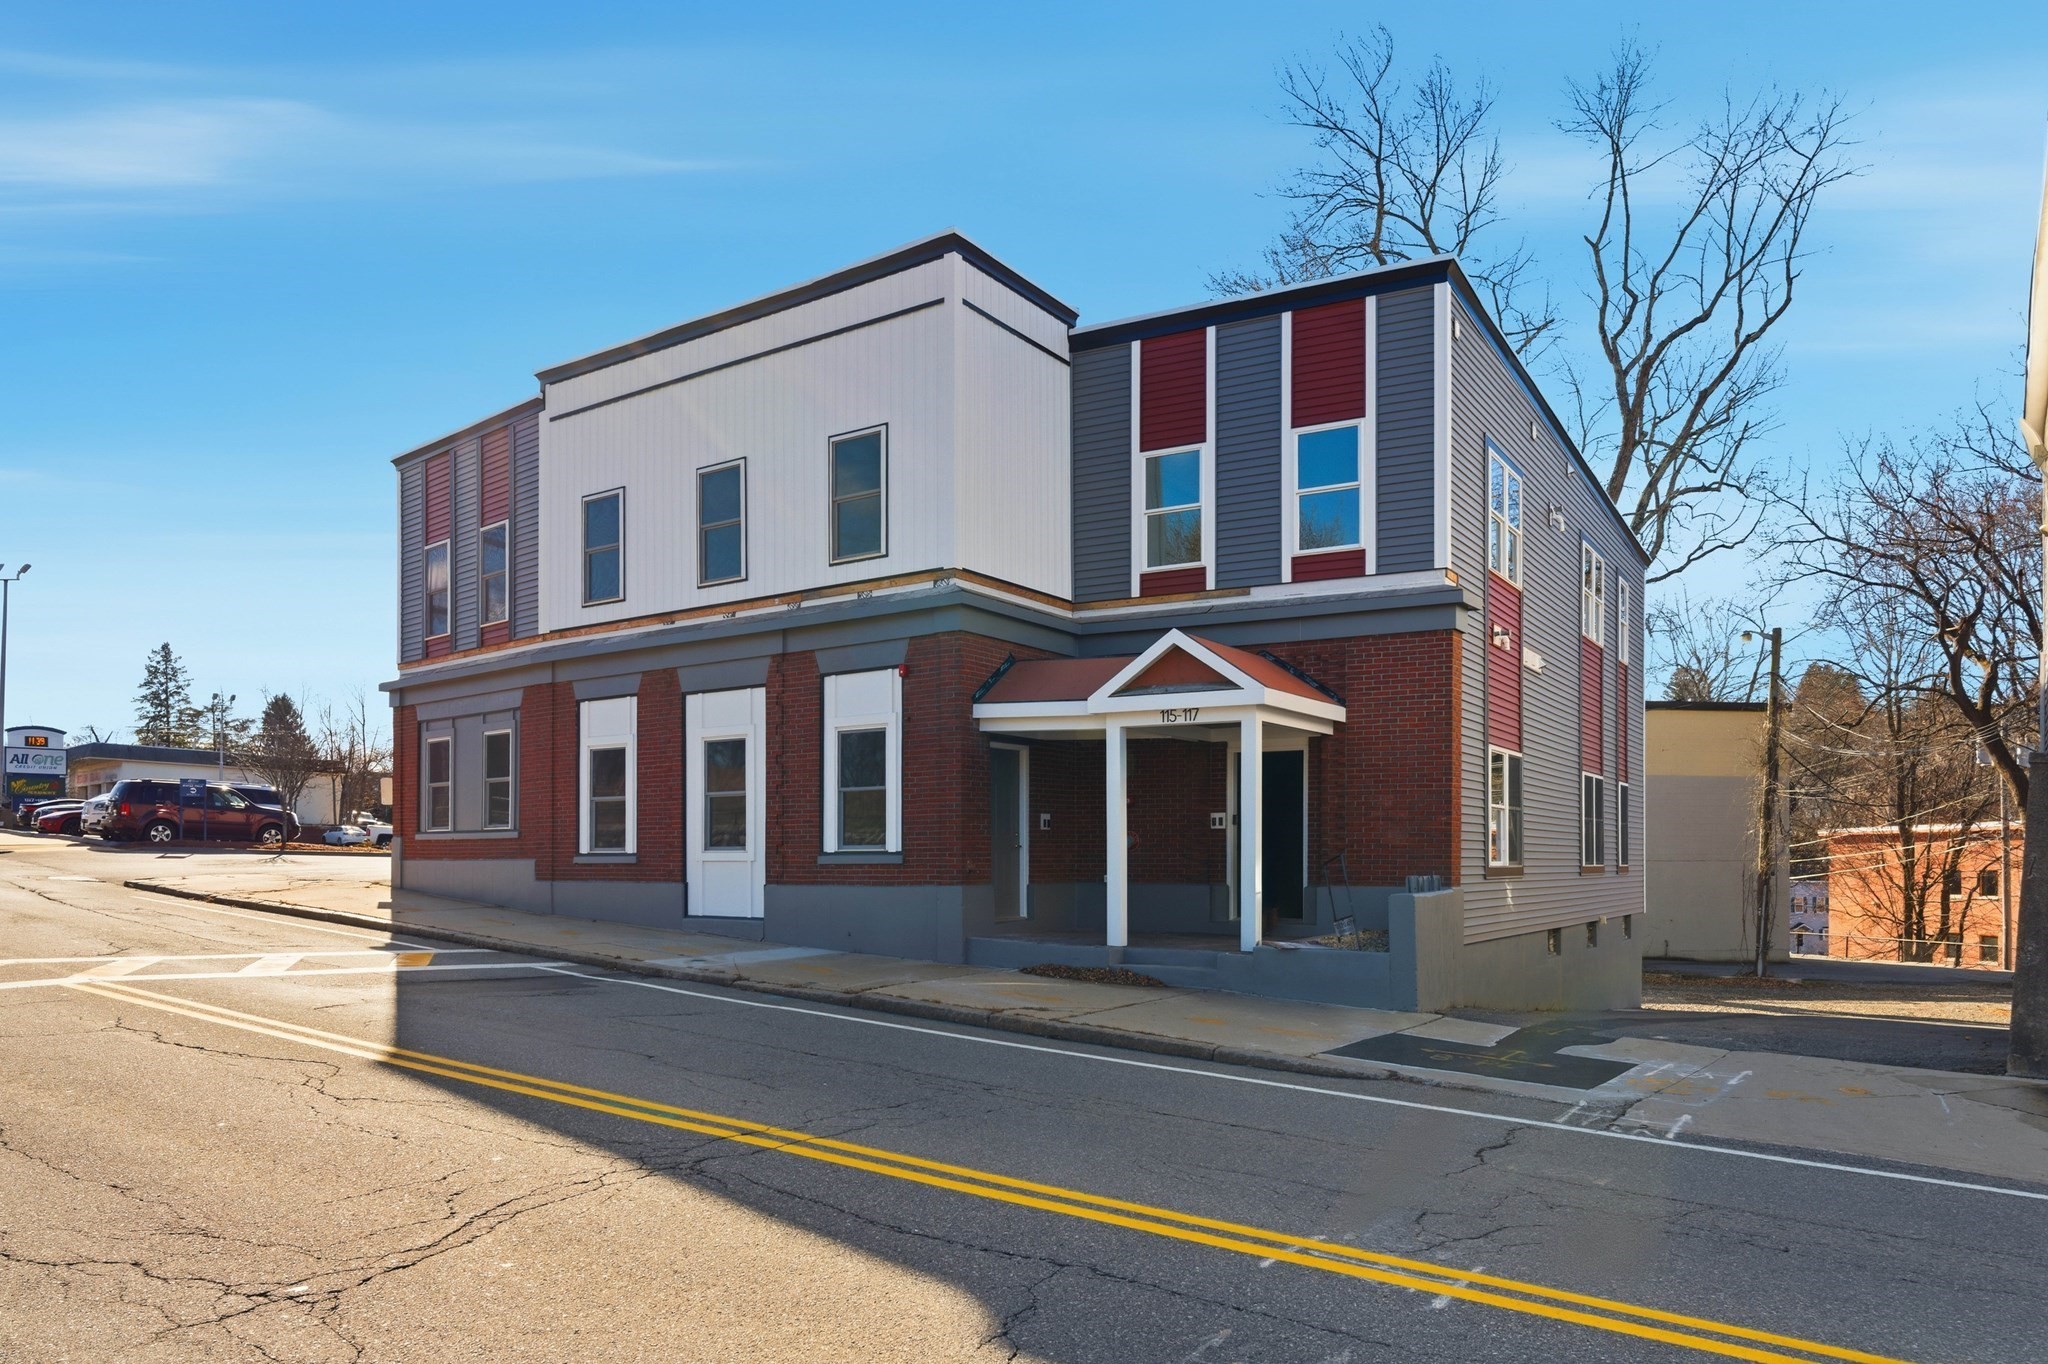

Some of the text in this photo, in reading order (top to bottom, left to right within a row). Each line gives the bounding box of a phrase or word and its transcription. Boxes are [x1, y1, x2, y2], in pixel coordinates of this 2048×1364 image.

[1159, 707, 1200, 723] 115-117
[9, 753, 64, 766] All One
